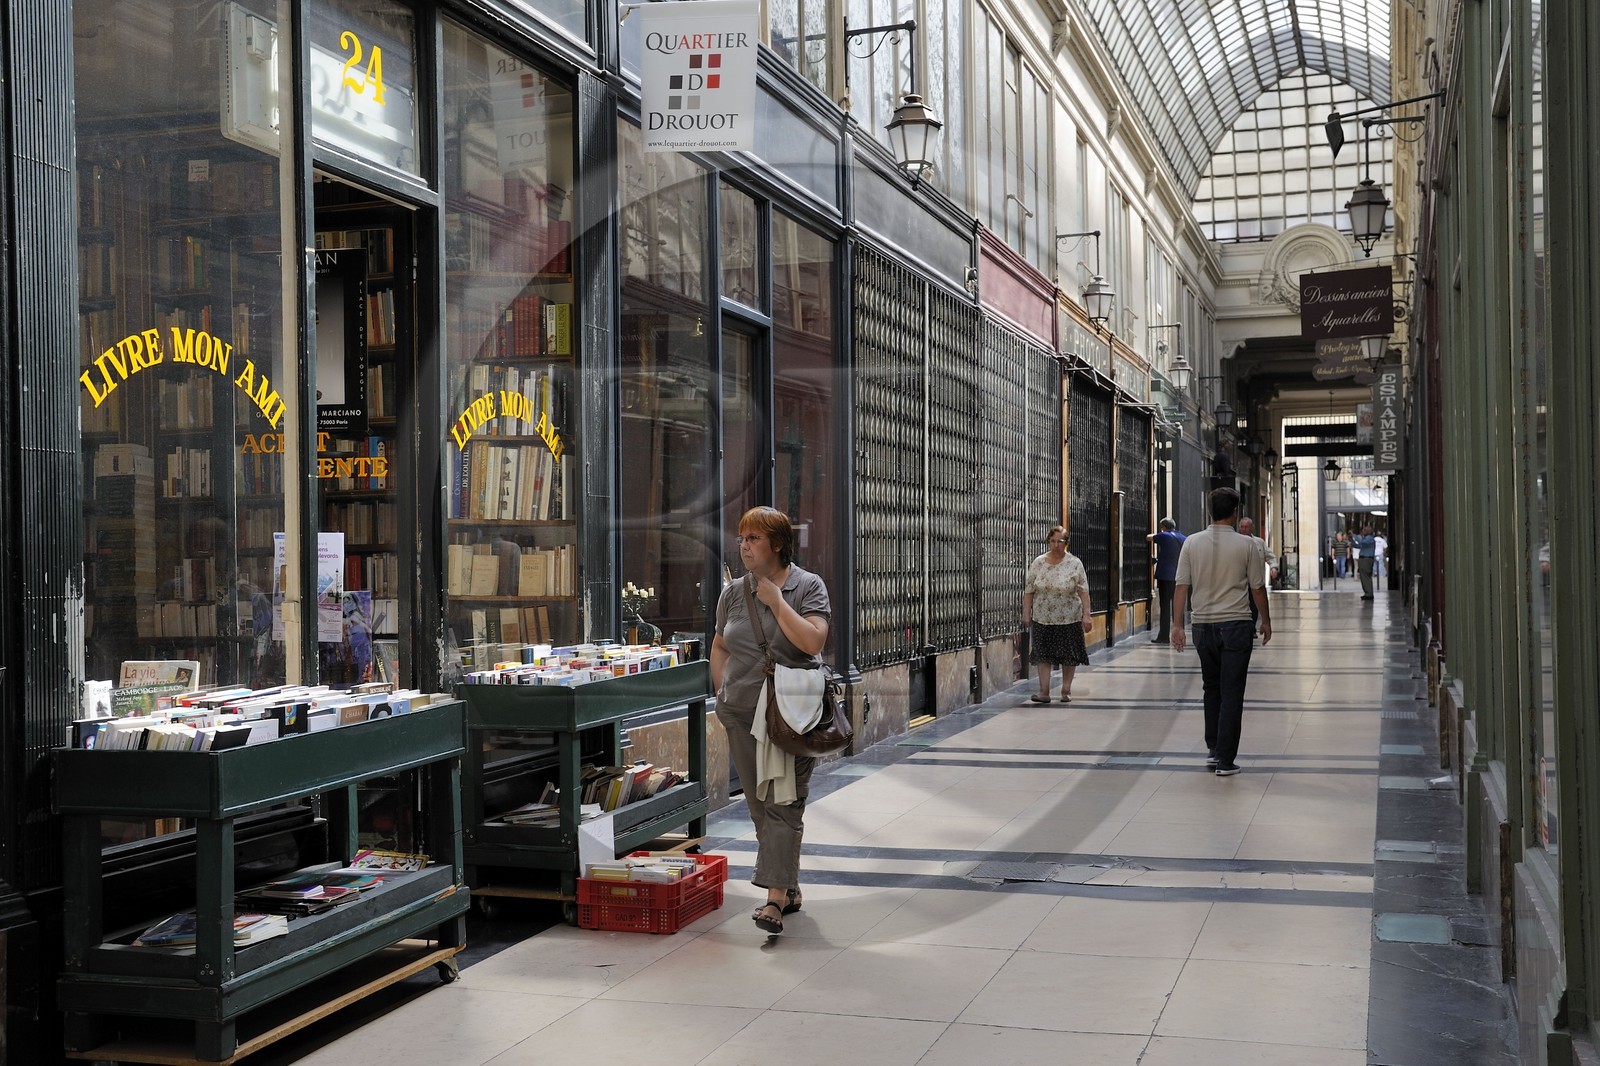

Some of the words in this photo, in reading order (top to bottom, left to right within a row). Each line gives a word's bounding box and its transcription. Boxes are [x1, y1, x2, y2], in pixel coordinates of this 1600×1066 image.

[340, 30, 387, 107] 24
[687, 73, 704, 91] D
[648, 111, 739, 131] DROUOT
[647, 139, 738, 149] www.lequartier-drouot.com
[1303, 285, 1350, 305] Dessins
[1350, 284, 1390, 301] anciens
[1312, 306, 1382, 334] Aquarelles
[79, 327, 164, 409] LIVRE
[170, 326, 233, 376] MON
[234, 358, 287, 430] AMI
[321, 409, 362, 417] MARCIANO
[1379, 373, 1397, 464] ESTAMPES
[450, 391, 496, 452] LIVRE
[500, 390, 534, 425] MON
[534, 411, 566, 464] AMI
[317, 457, 389, 479] ENTE
[124, 666, 137, 679] La
[140, 666, 156, 678] vie
[114, 686, 159, 697] CAMBODGE
[163, 684, 184, 694] LAOS
